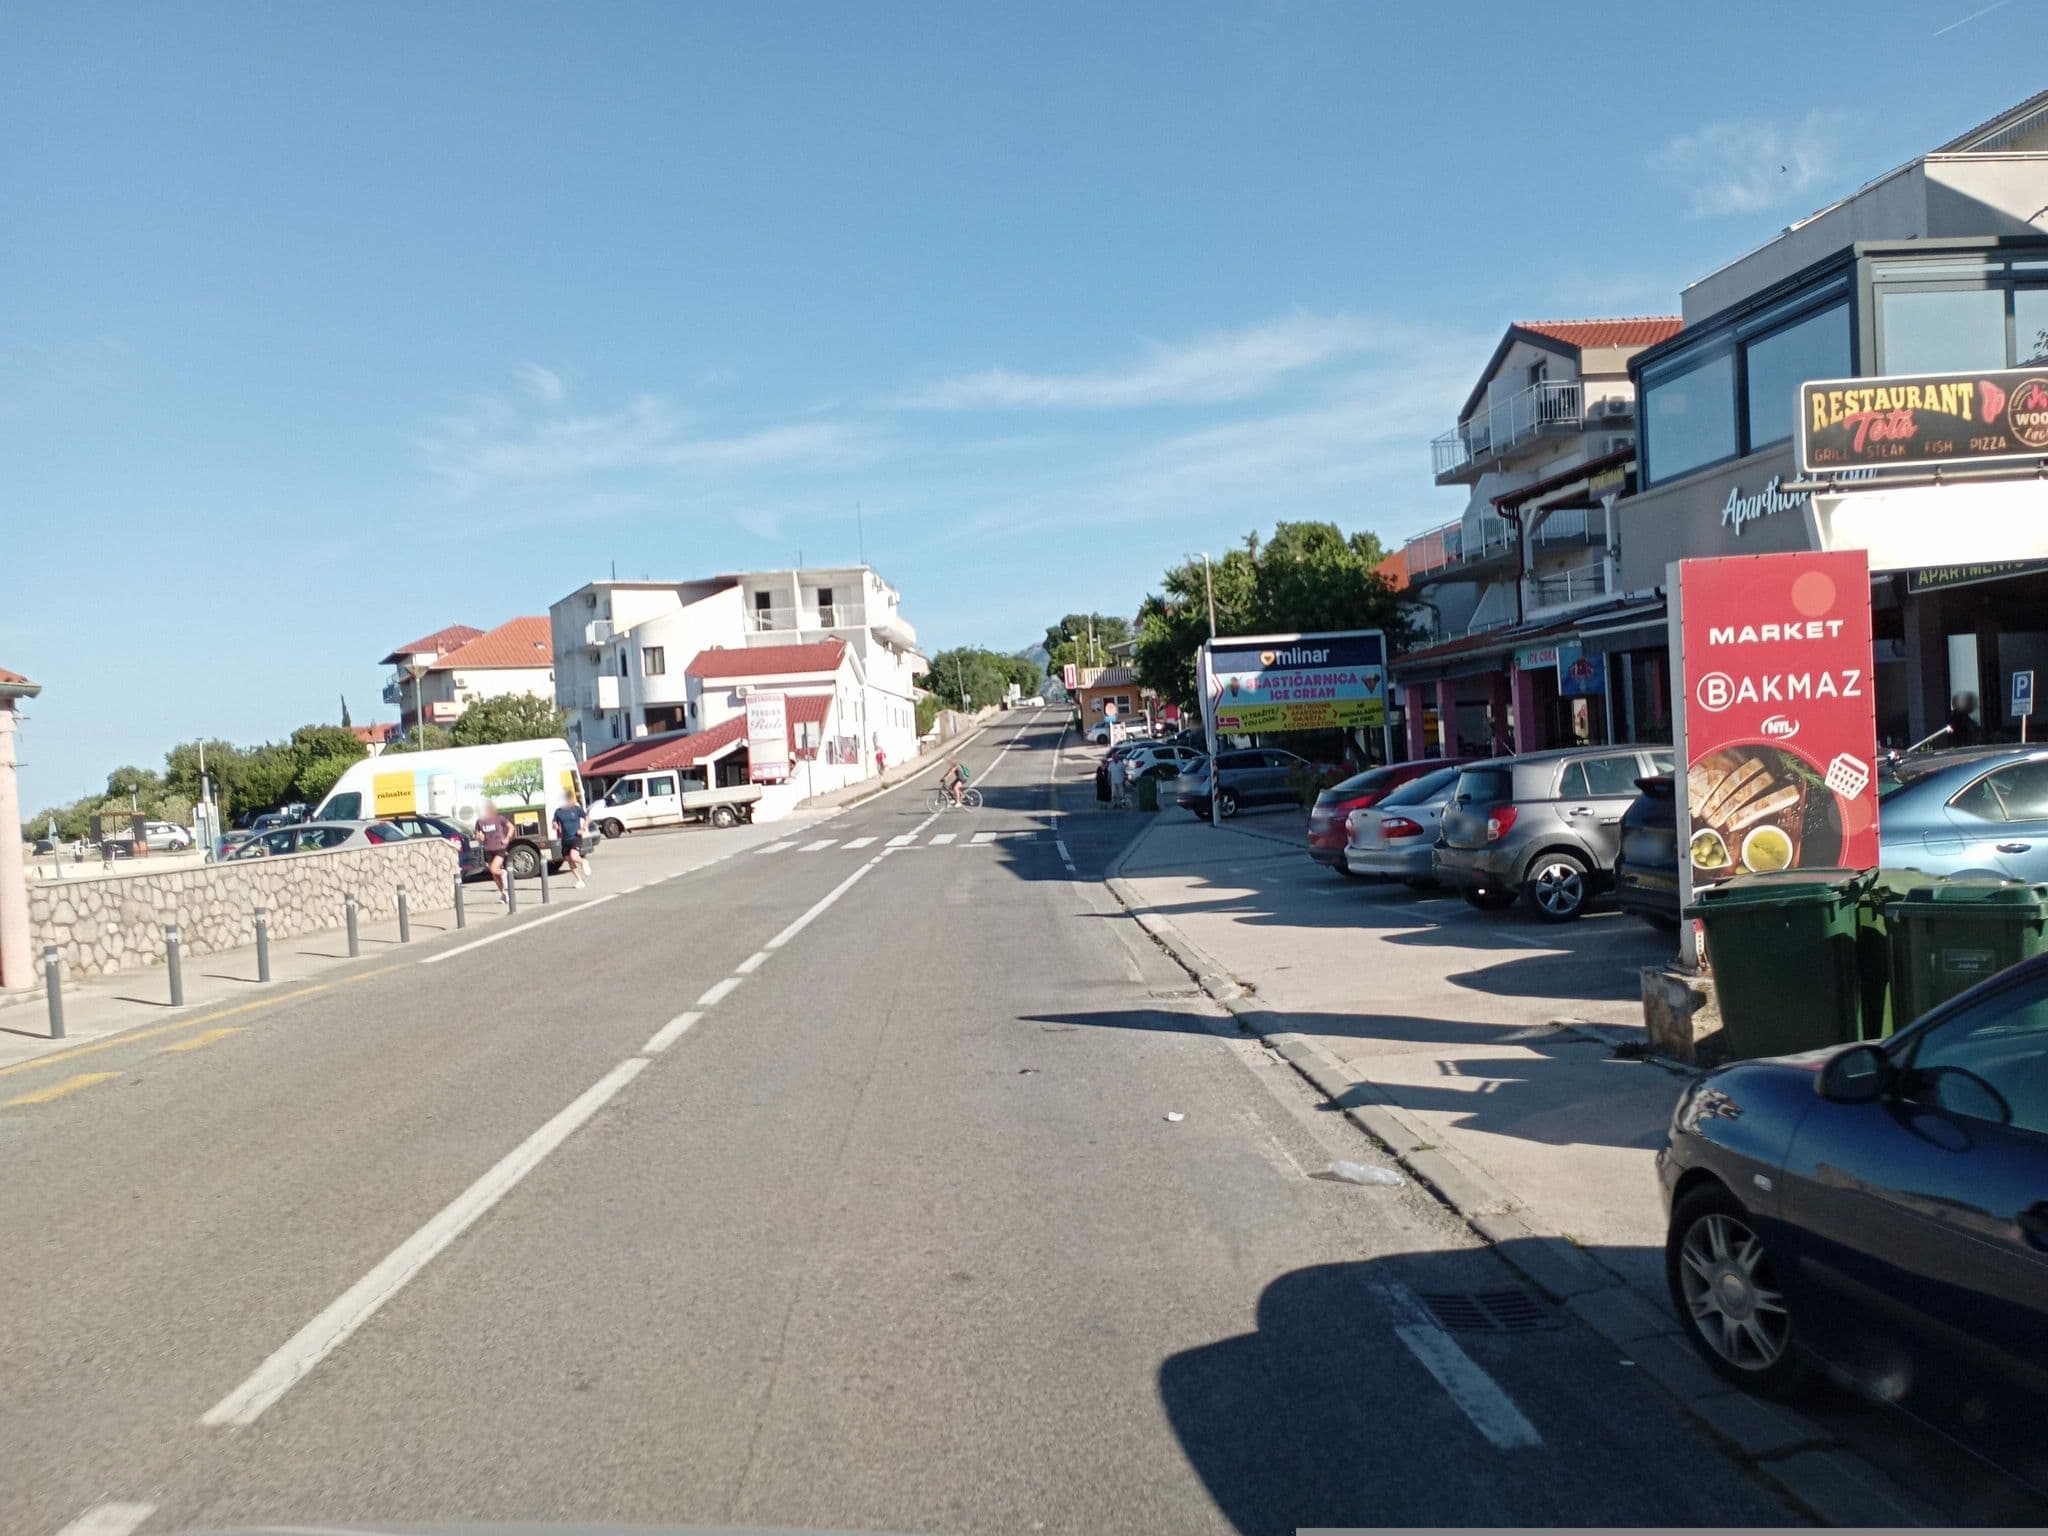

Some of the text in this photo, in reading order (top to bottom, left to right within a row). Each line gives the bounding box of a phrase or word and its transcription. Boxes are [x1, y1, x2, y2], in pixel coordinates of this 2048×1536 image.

[1811, 382, 1973, 433] RESTAURANT
[1814, 436, 2007, 462] GRILL STEAK FISH PIZZA
[1708, 619, 1844, 646] MARKET
[1276, 647, 1330, 666] mlinar
[1246, 672, 1358, 689] SLASTIČARNICA
[1697, 668, 1862, 711] BAKMAZ
[2016, 675, 2029, 698] P
[1270, 686, 1336, 700] ICE CREAM
